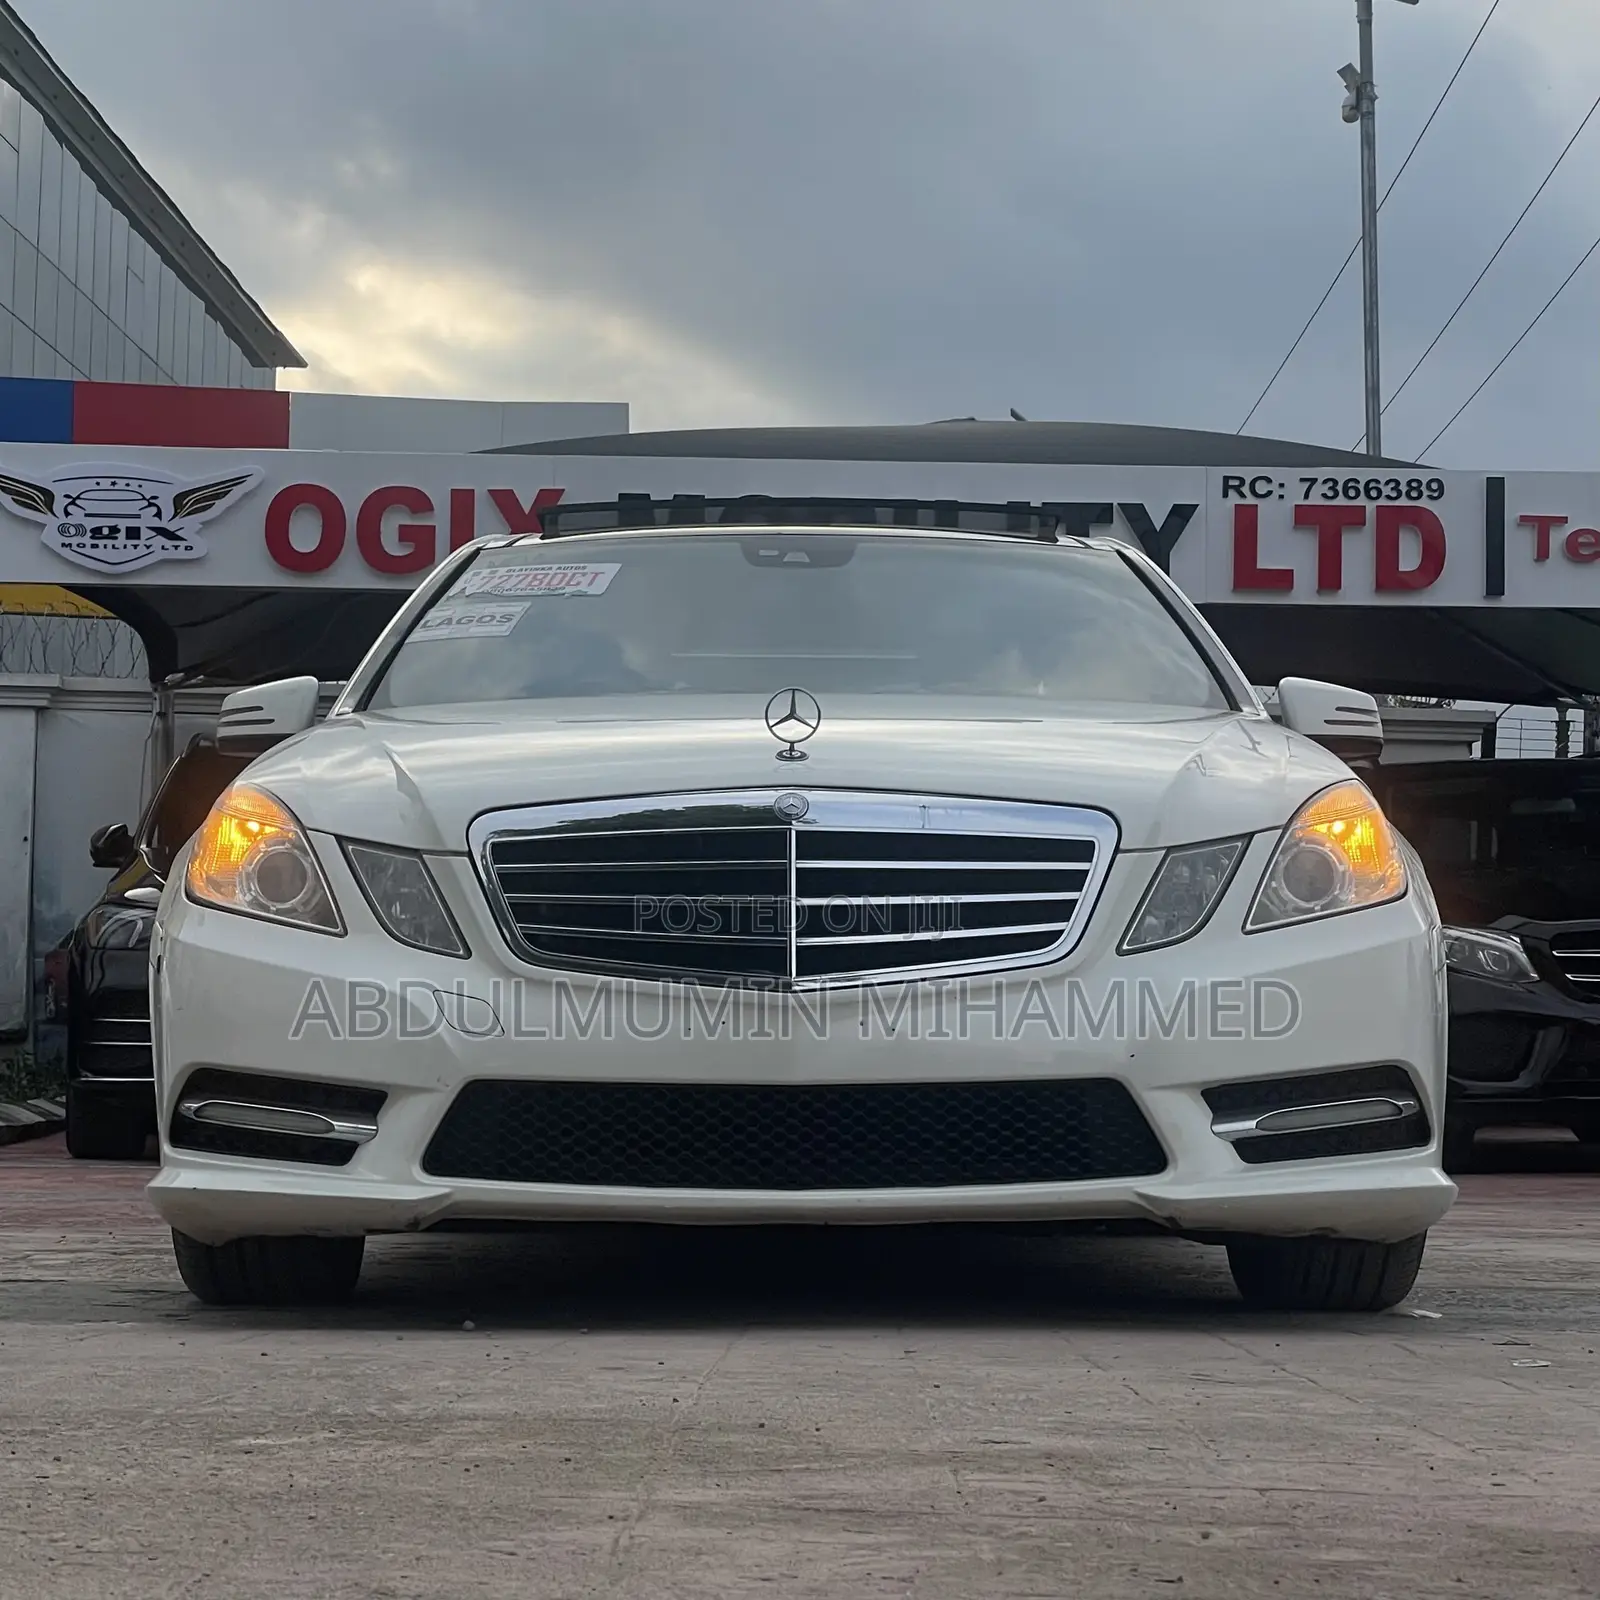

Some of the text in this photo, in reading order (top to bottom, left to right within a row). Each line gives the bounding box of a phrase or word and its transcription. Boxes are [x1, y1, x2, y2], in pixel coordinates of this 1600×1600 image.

[1221, 474, 1446, 501] RC: 7366389
[60, 541, 195, 552] MOBILITY LTD
[1232, 503, 1447, 592] LTD
[555, 564, 588, 572] AUTOS
[419, 613, 516, 630] LAGOS
